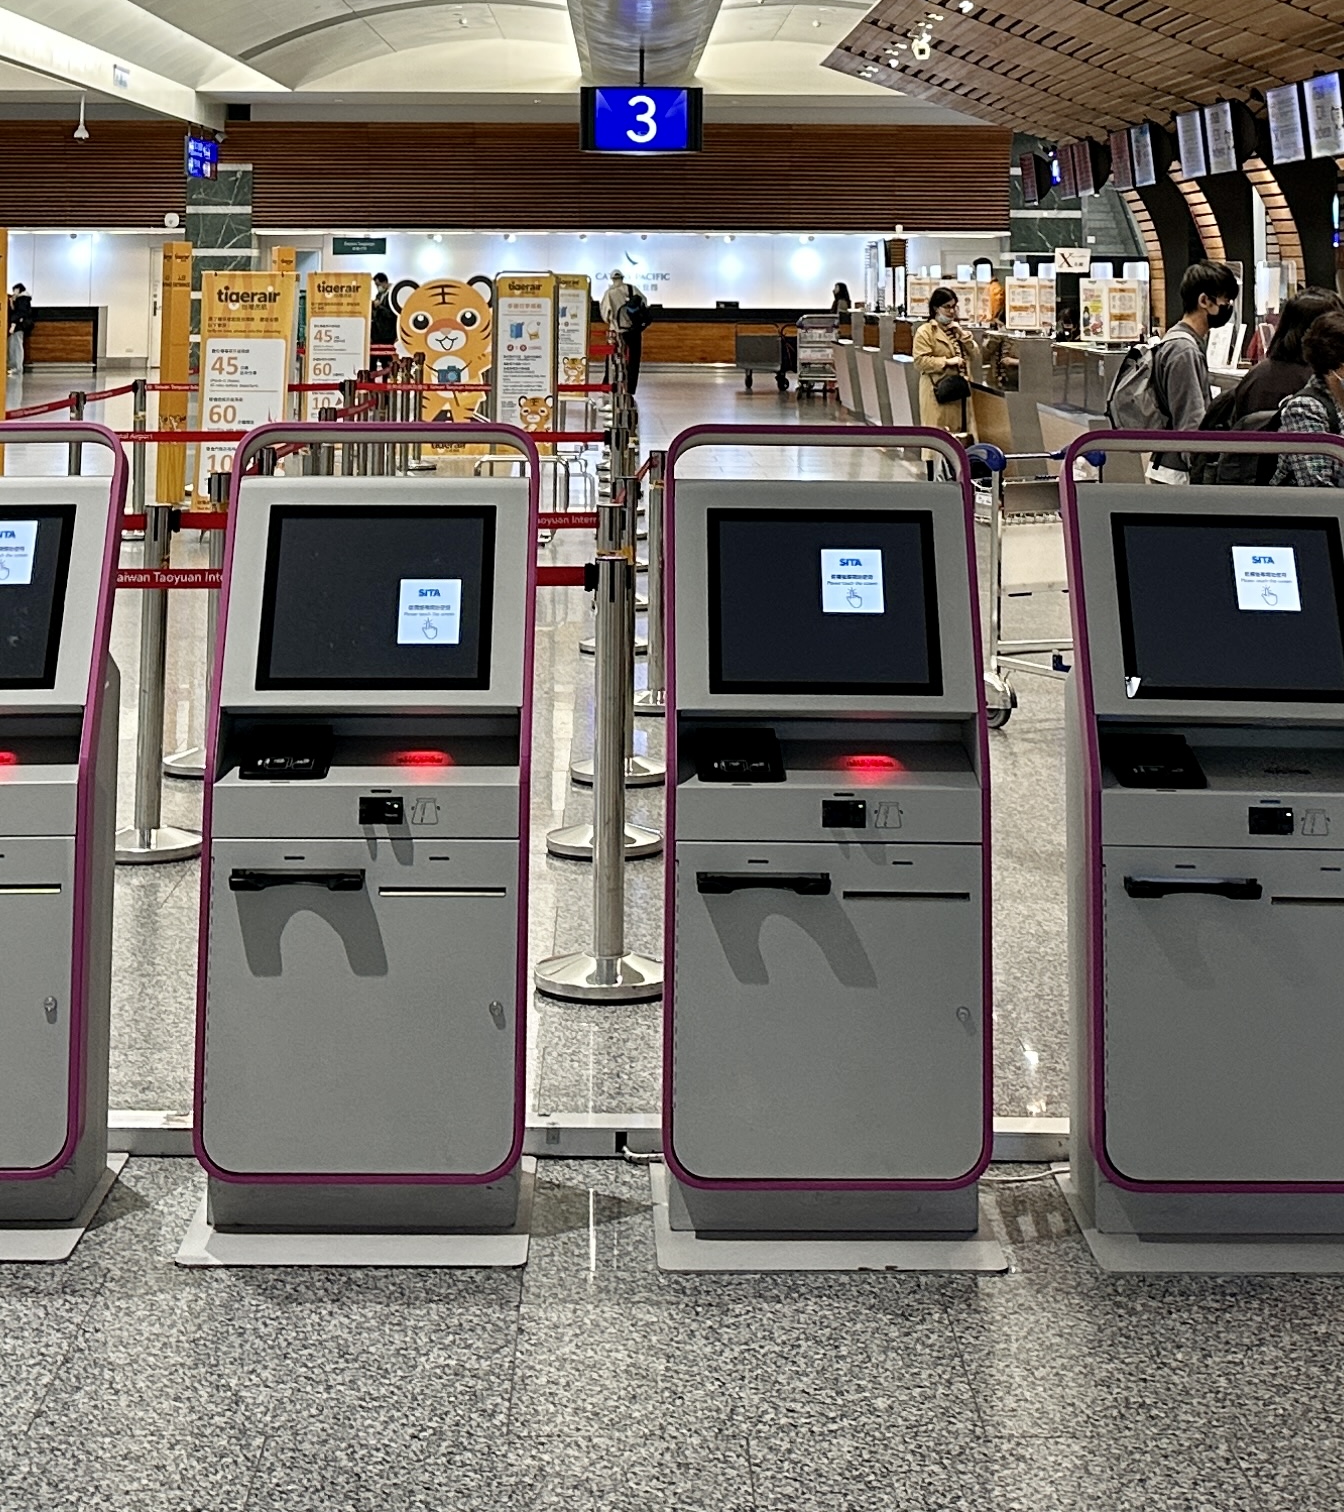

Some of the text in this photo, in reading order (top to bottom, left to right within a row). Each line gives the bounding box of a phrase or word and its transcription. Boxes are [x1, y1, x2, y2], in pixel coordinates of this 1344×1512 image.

[626, 95, 658, 143] 3
[216, 285, 281, 304] tigerair
[313, 329, 333, 343] 45
[210, 356, 239, 375] 45
[312, 363, 332, 377] 60
[209, 405, 237, 424] 60
[839, 558, 863, 567] SITA
[1252, 555, 1275, 564] SITA
[116, 571, 151, 583] aiwan
[153, 571, 202, 585] Taoyuan
[418, 589, 441, 597] SITA
